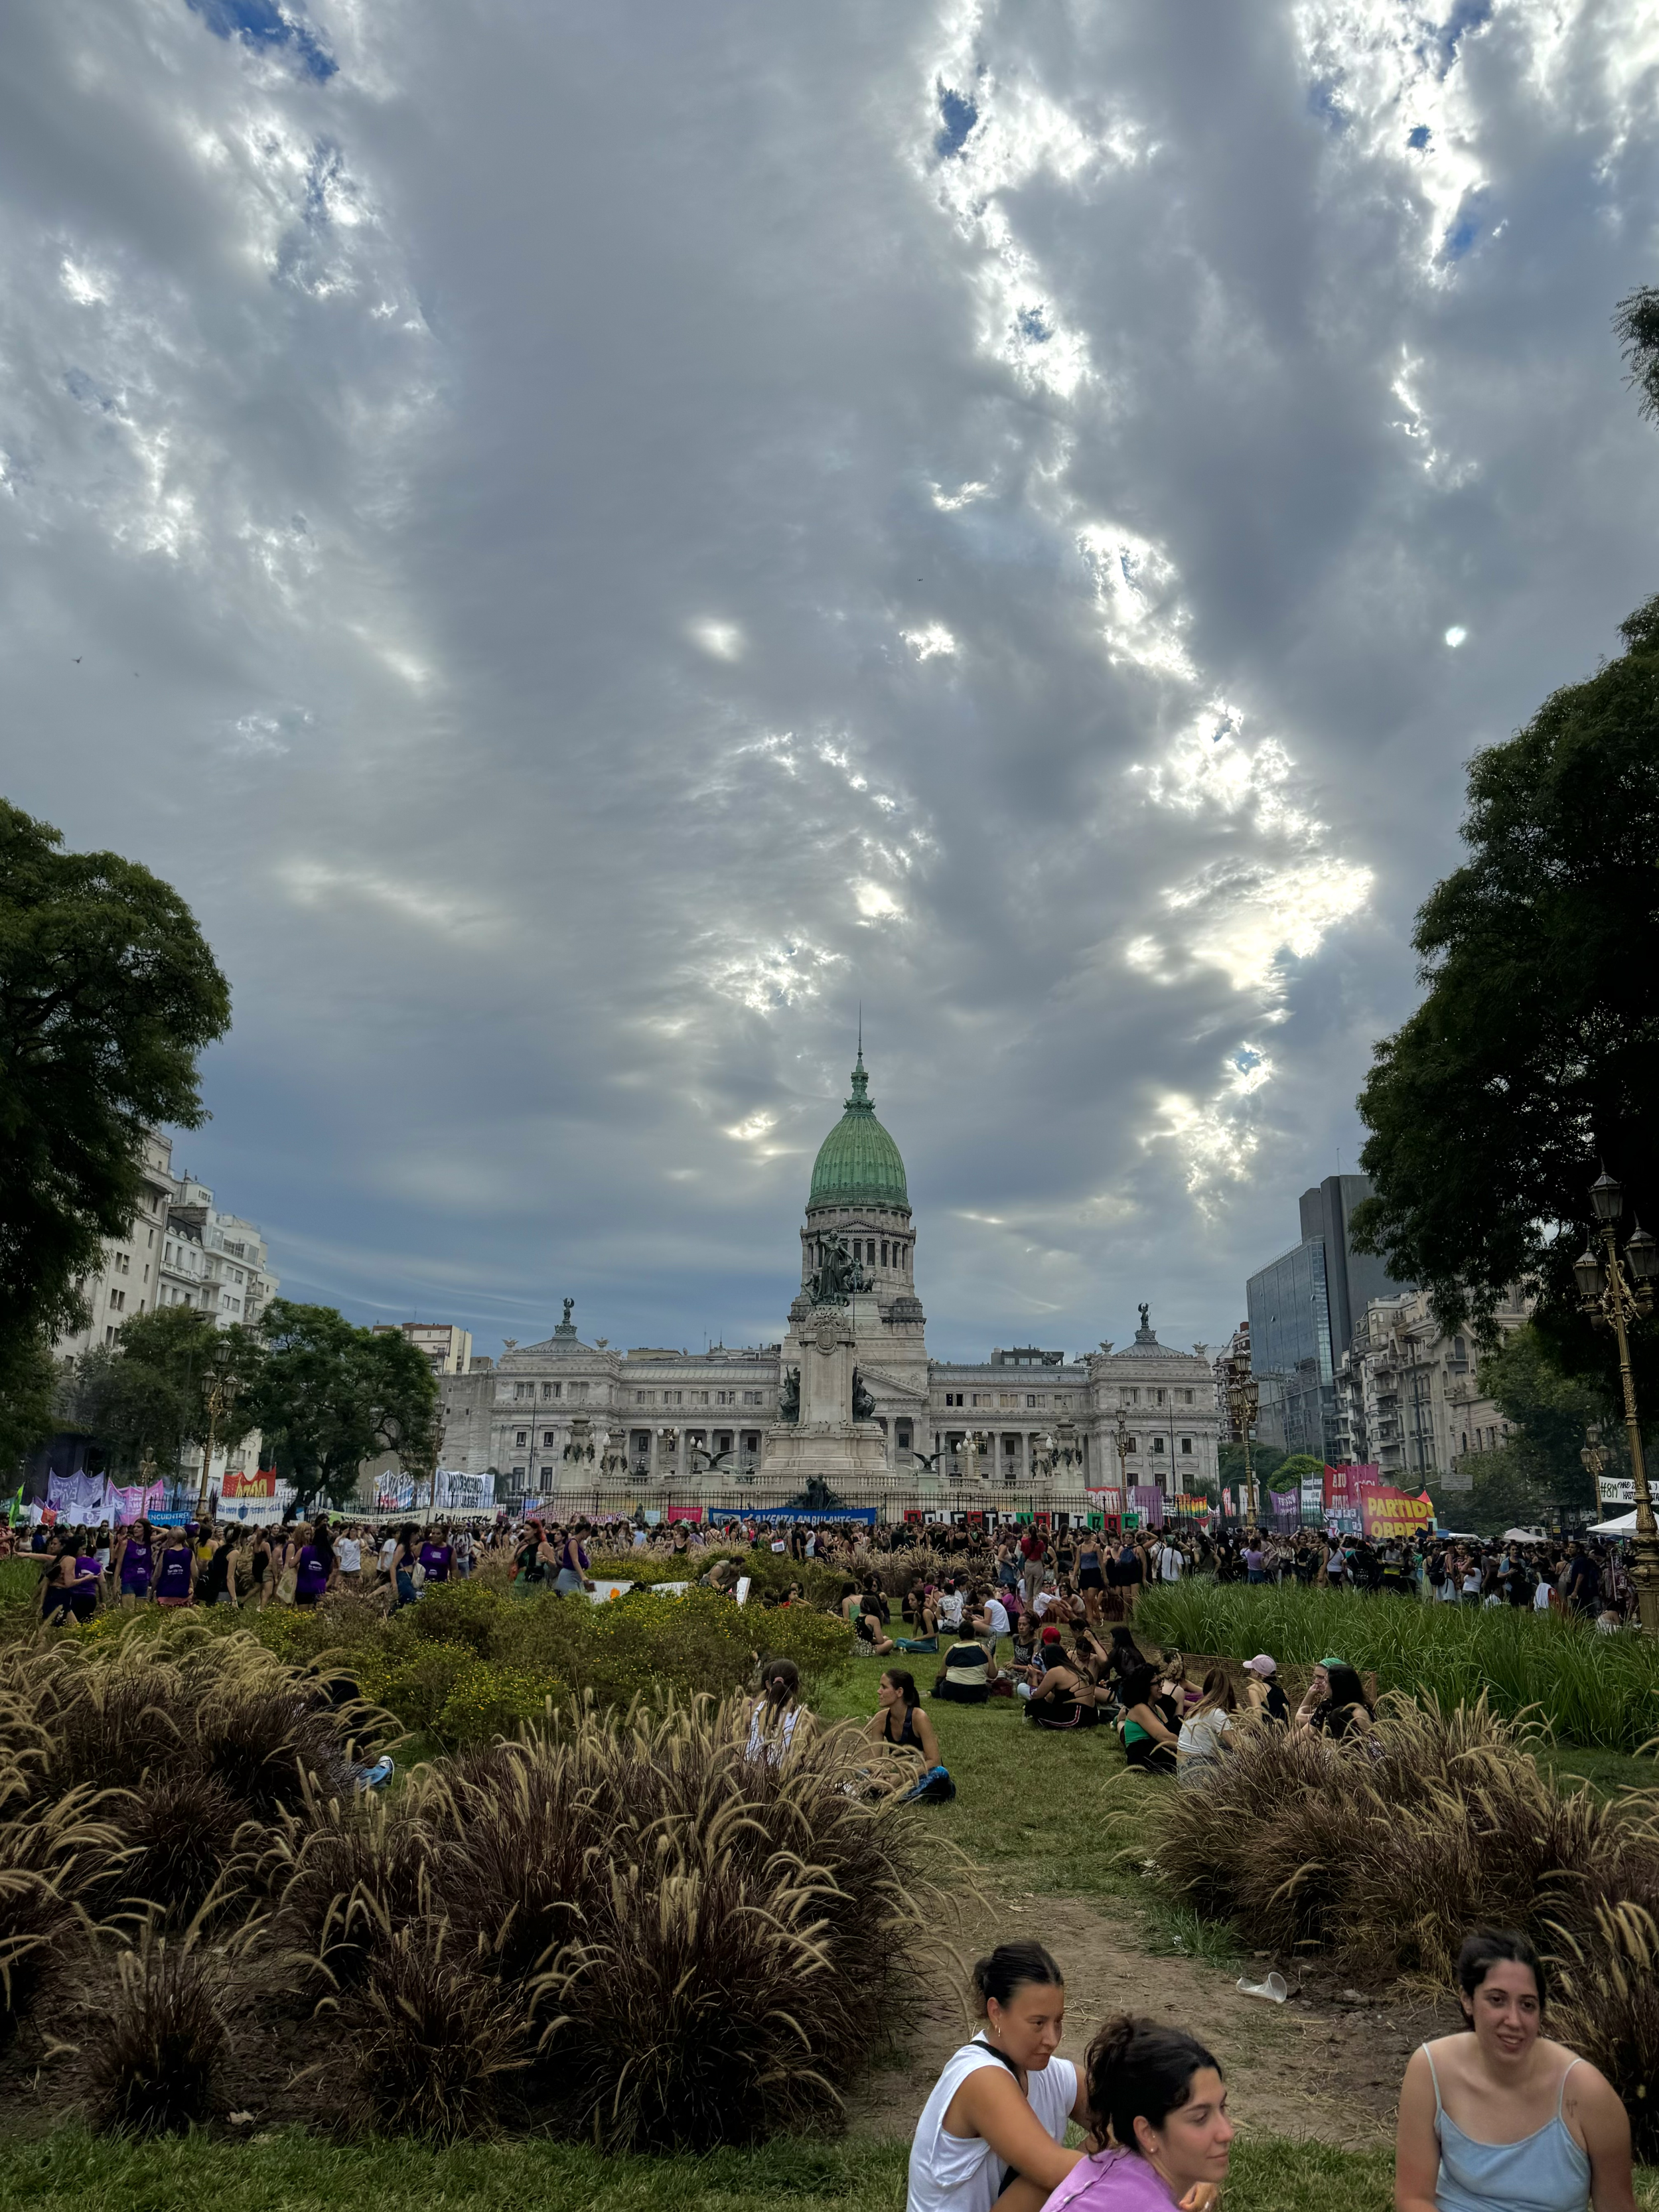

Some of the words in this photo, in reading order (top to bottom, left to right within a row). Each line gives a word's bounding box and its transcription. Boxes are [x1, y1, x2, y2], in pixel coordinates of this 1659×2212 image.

[1601, 1481, 1618, 1499] #8M
[1368, 1497, 1435, 1518] PARTIDO
[435, 1513, 445, 1524] LA
[762, 1514, 795, 1525] VENTA
[797, 1515, 851, 1526] AMBULANTE
[1371, 1520, 1428, 1538] OBRER
